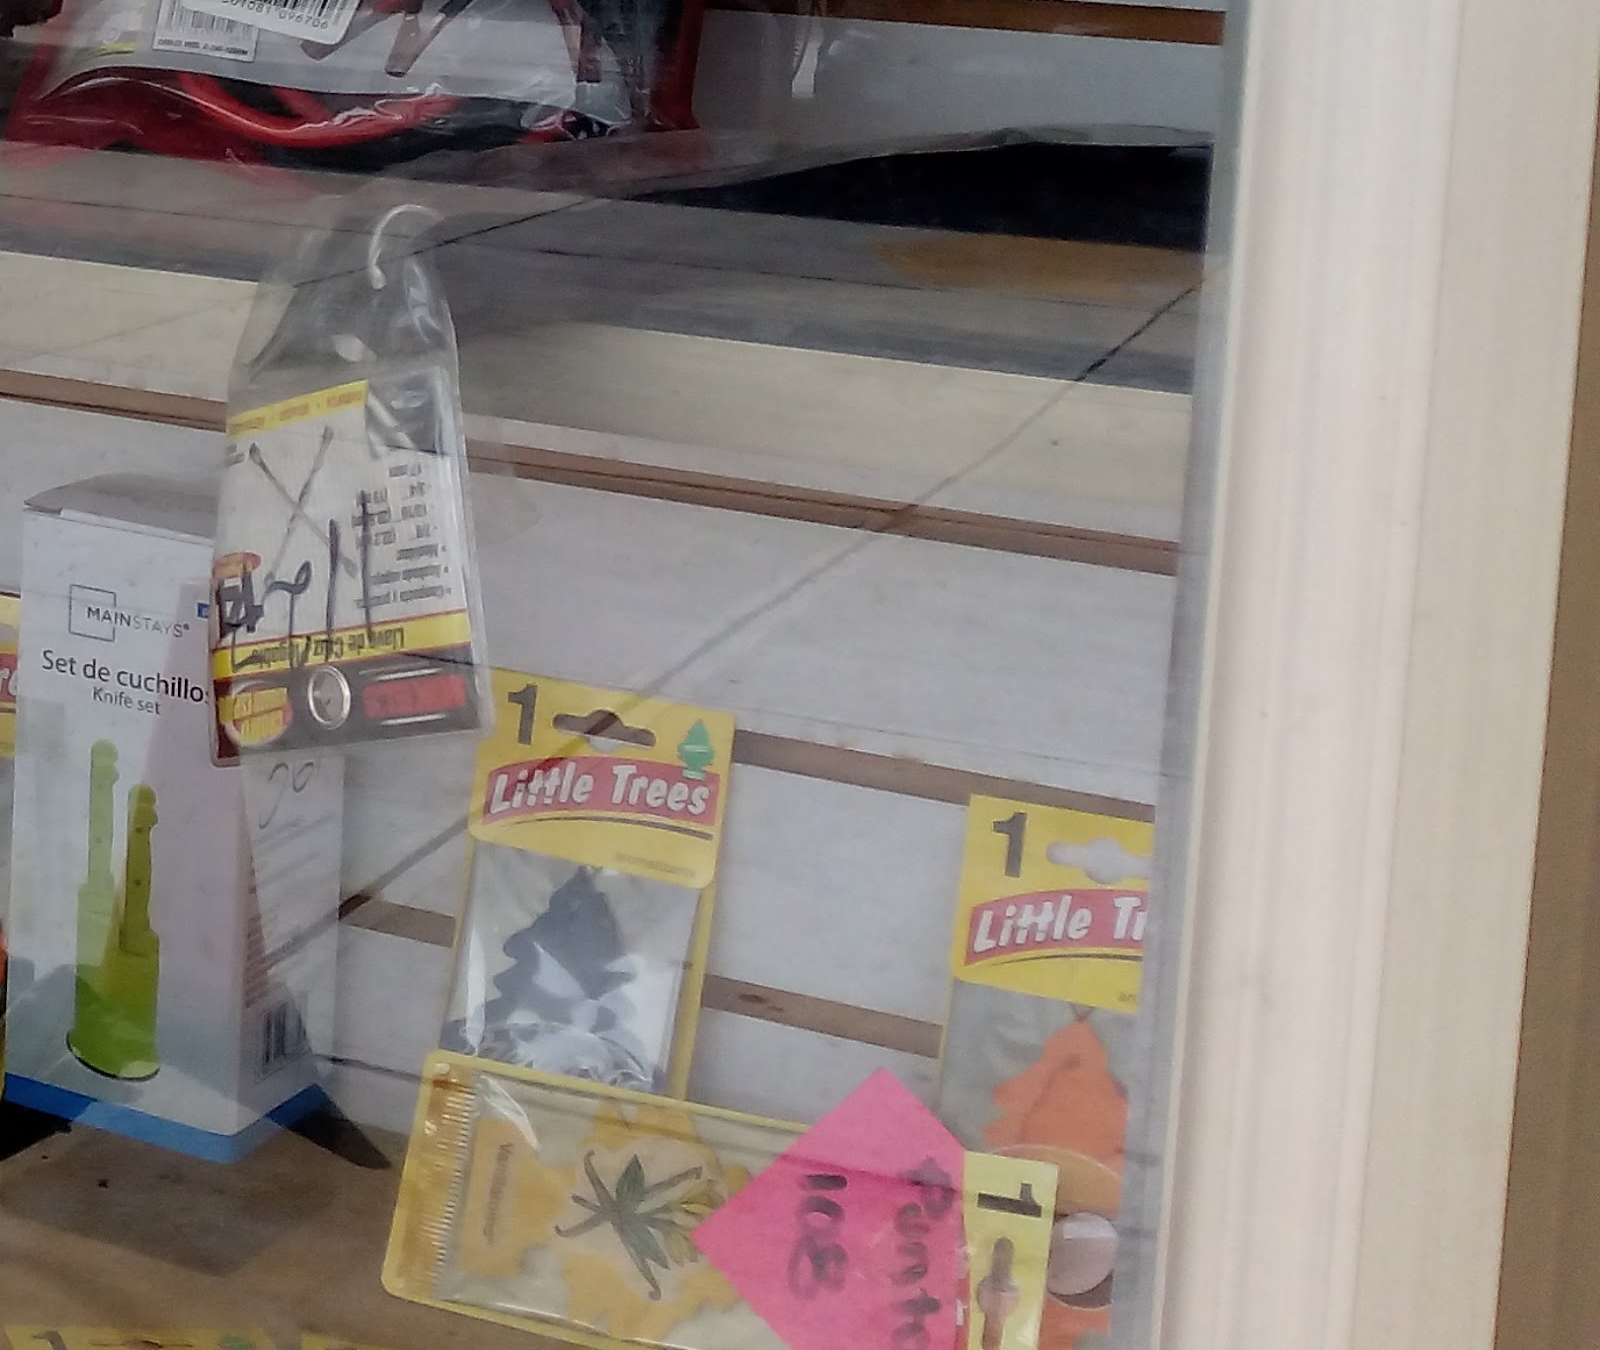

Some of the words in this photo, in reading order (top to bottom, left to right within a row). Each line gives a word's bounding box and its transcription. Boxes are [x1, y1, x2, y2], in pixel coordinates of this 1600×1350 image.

[42, 649, 77, 676] Set
[83, 659, 112, 683] de
[92, 686, 133, 709] Knife
[137, 696, 161, 716] set
[506, 683, 539, 745] 1
[489, 760, 594, 815] Little
[611, 763, 711, 815] Trees
[992, 812, 1028, 878] 1
[974, 895, 1092, 953] Little
[977, 1183, 1043, 1219] 1
